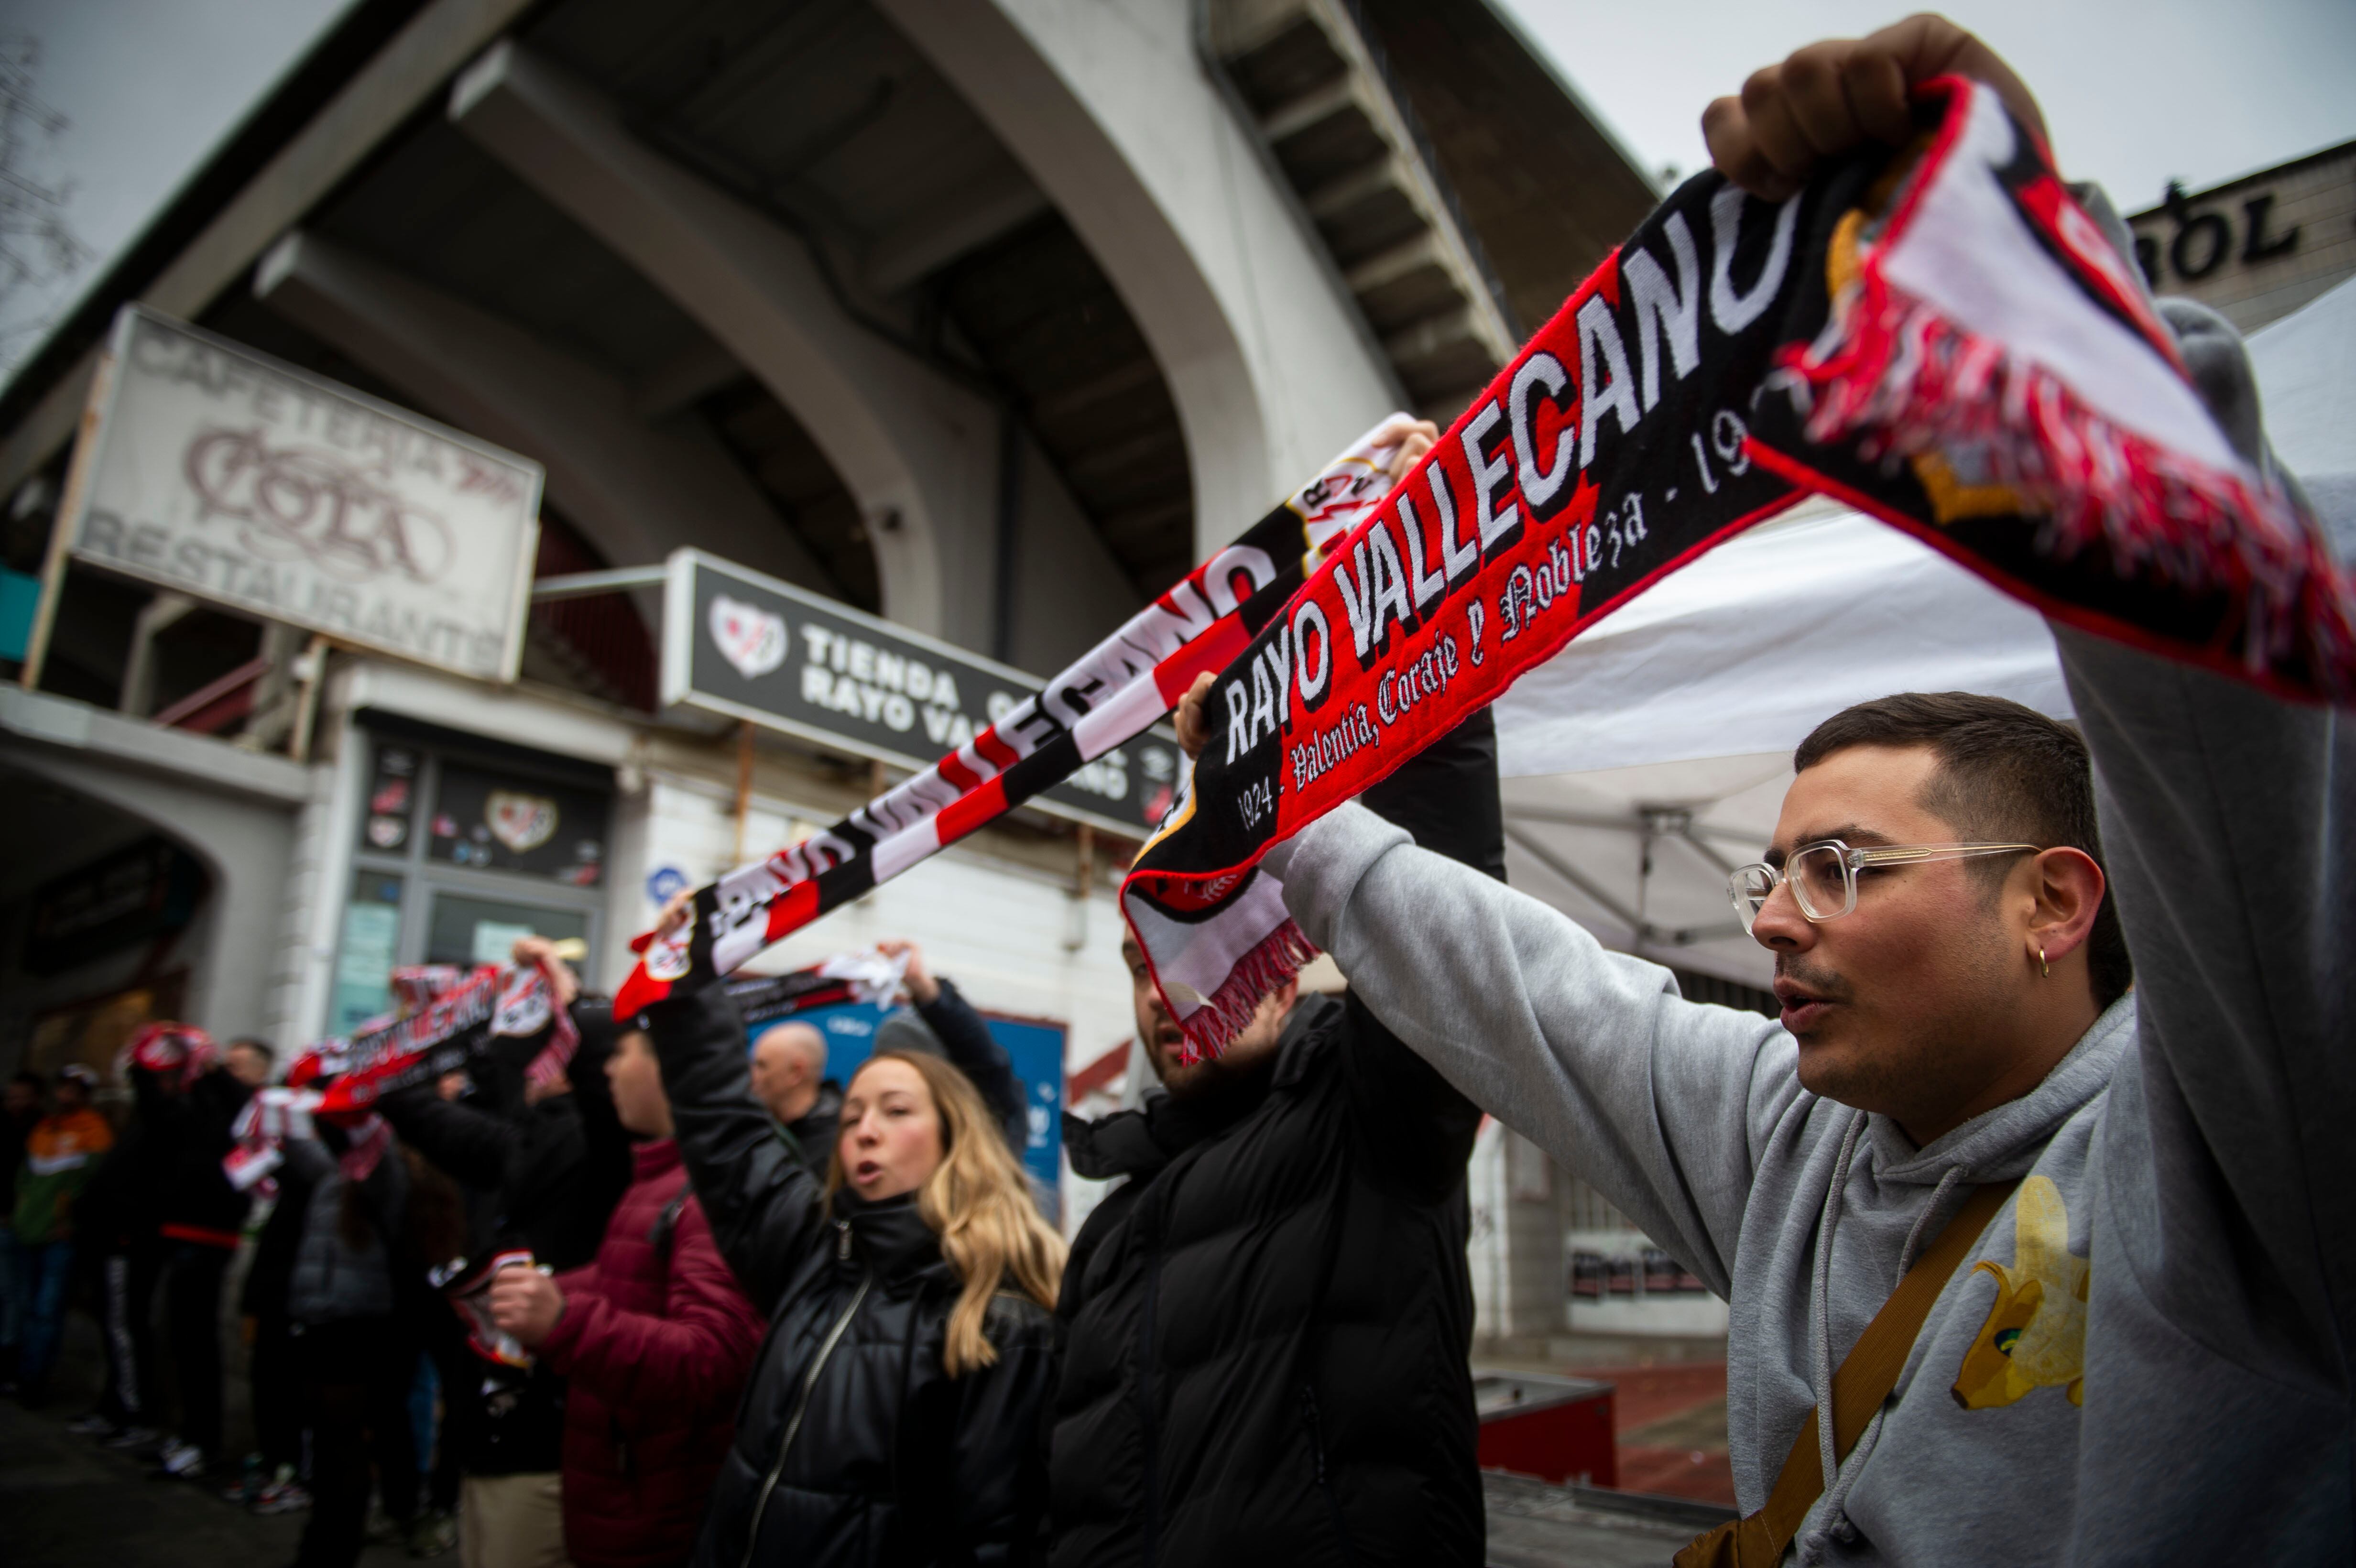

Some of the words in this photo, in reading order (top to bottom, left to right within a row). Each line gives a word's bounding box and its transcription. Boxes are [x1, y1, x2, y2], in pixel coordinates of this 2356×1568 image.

[1225, 599, 1330, 765] RAYO
[1334, 184, 1801, 659] VALLECANO
[800, 623, 960, 711] TIENDA
[800, 664, 916, 732] RAYO
[1237, 775, 1273, 831] 1924
[1291, 702, 1379, 792] Valentía,
[1378, 630, 1459, 725] Coraje
[1500, 492, 1648, 642] Nobleza
